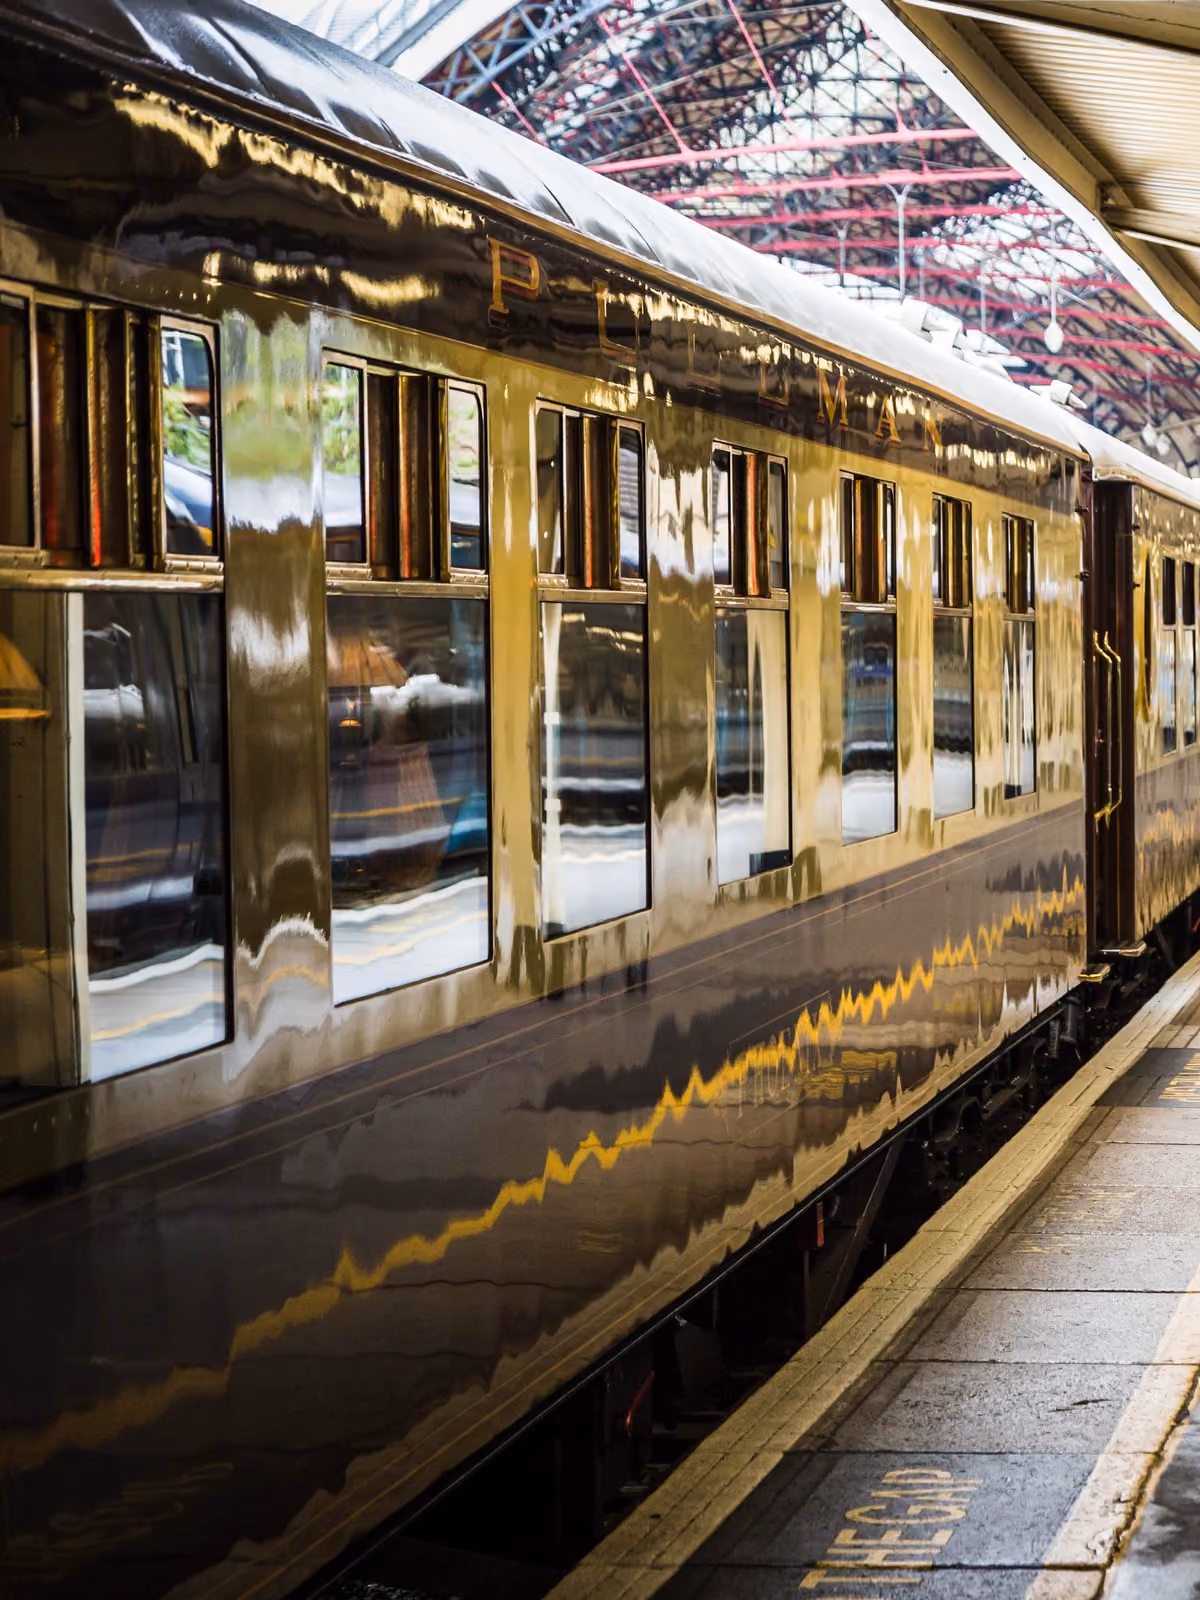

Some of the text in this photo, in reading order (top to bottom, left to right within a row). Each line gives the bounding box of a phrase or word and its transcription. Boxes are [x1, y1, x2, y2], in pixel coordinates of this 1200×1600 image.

[488, 236, 944, 452] PULLMAN
[845, 1468, 984, 1524] GAP
[799, 1529, 953, 1588] THE
